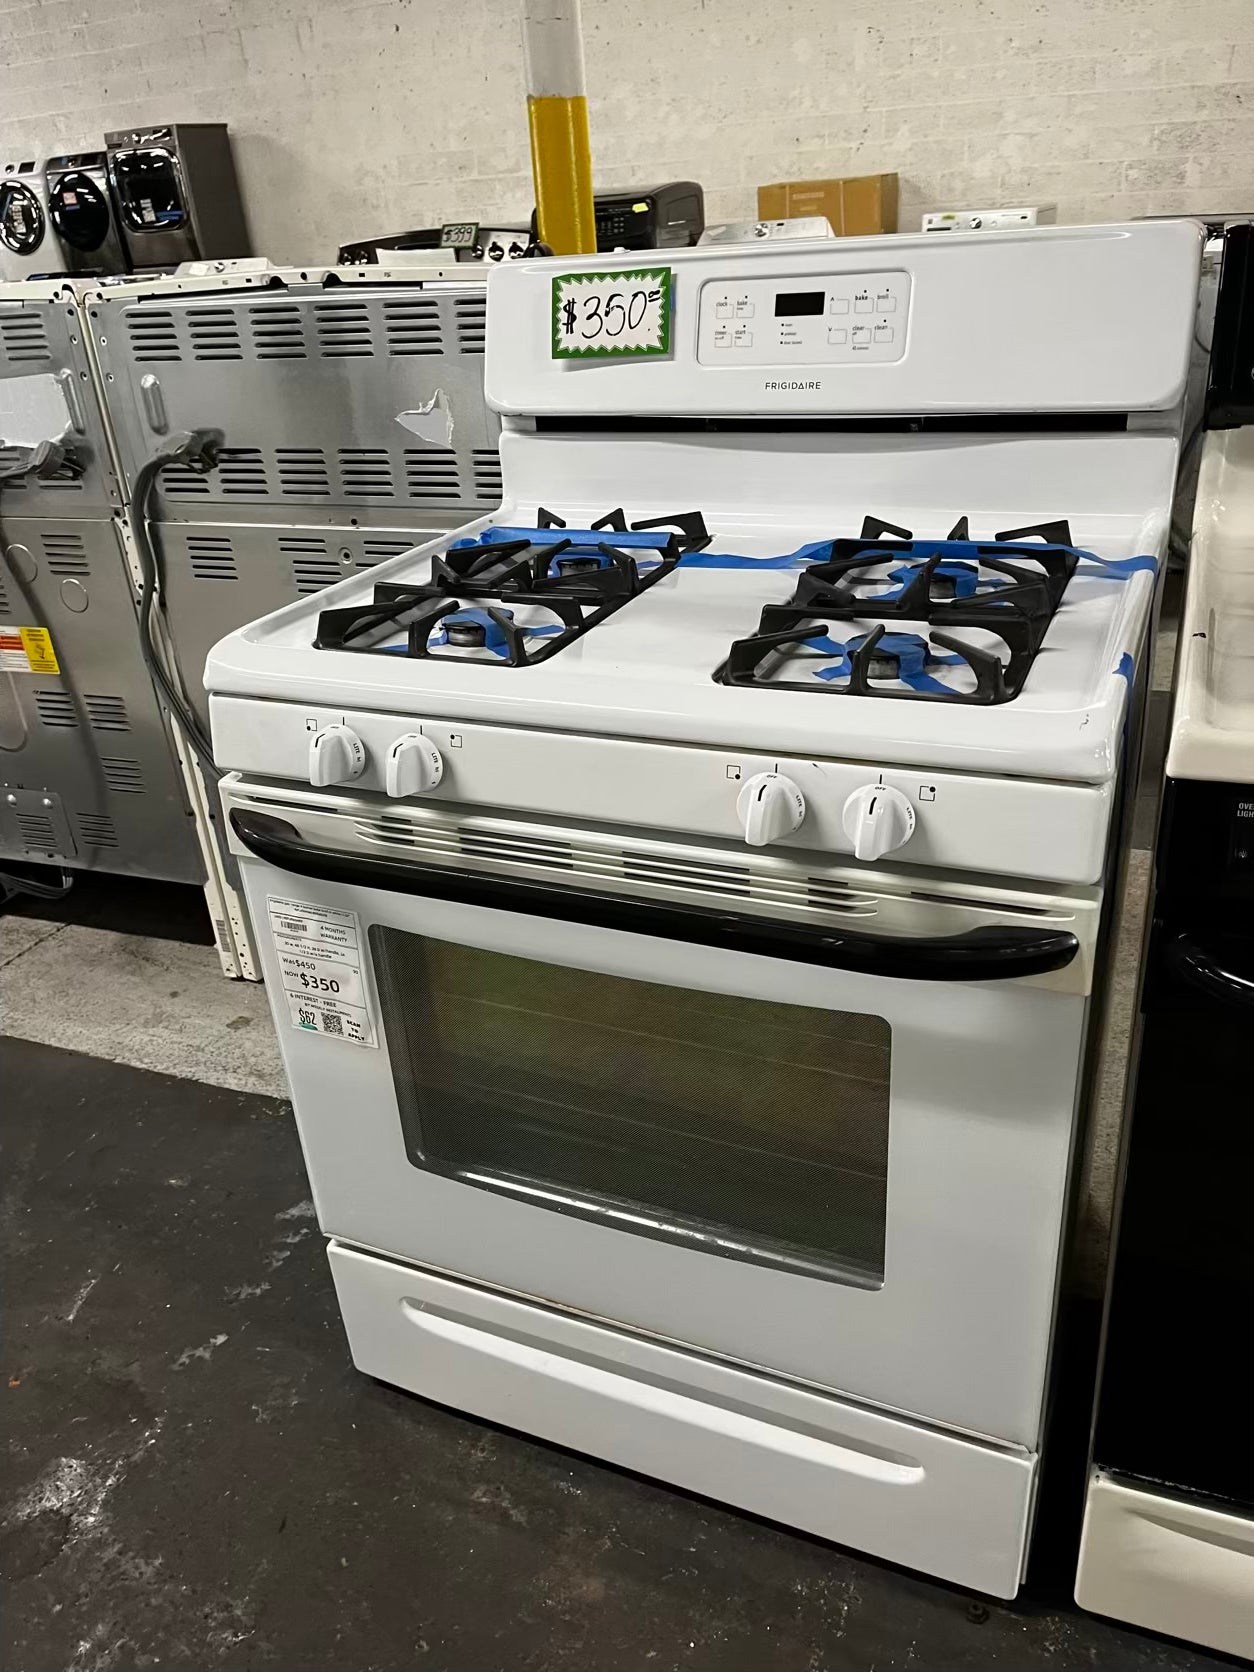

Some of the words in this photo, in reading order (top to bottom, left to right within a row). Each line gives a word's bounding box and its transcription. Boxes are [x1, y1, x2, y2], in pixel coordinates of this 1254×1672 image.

[765, 381, 822, 390] FRIGIDAIRE
[1238, 802, 1254, 810] OVE
[1237, 810, 1254, 818] LIGH
[324, 926, 346, 935] MONTHS
[320, 933, 348, 943] WARRANTY
[295, 958, 316, 971] $450
[284, 970, 299, 978] NOW
[299, 972, 340, 993] $350
[294, 994, 319, 1003] INTEREST
[298, 1007, 317, 1025] $62
[346, 1019, 361, 1028] SCAN
[348, 1032, 365, 1041] APPLY
